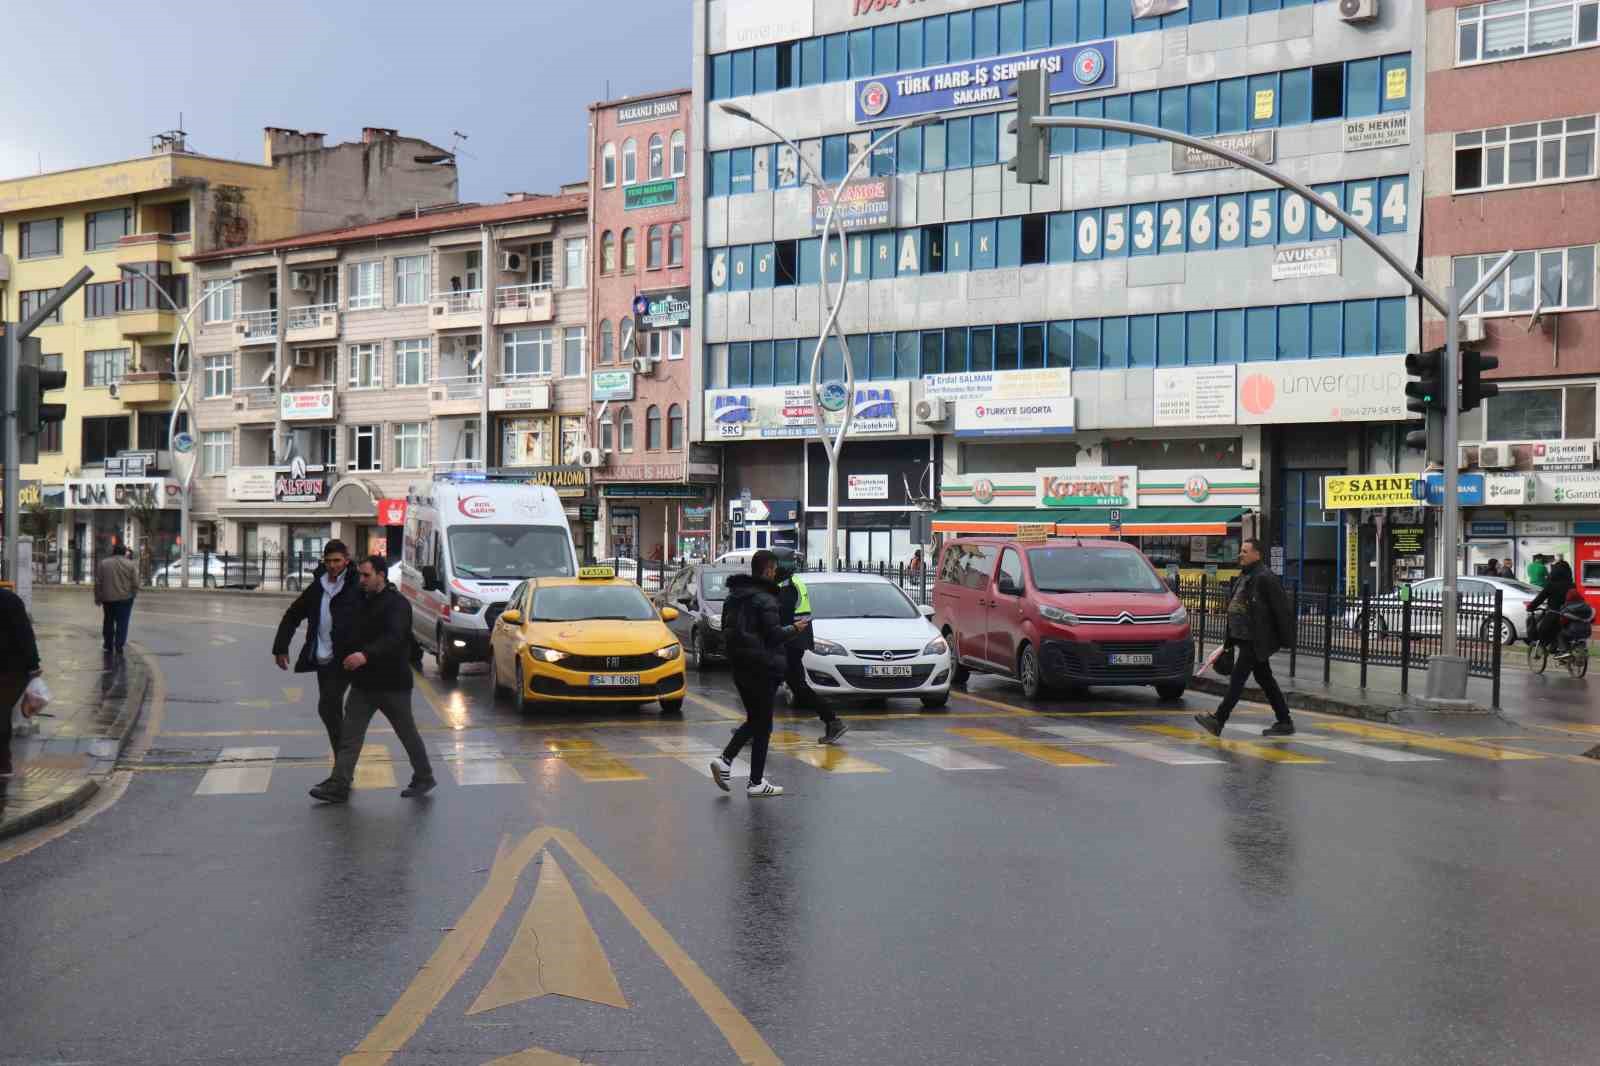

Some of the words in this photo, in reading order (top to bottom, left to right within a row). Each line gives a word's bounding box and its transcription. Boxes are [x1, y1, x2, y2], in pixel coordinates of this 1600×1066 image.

[897, 77, 931, 96] TÜRK
[934, 64, 988, 87] HARB-İŞ
[952, 87, 1001, 105] SAKARYA
[721, 426, 740, 435] SRC
[69, 484, 109, 505] TUNA
